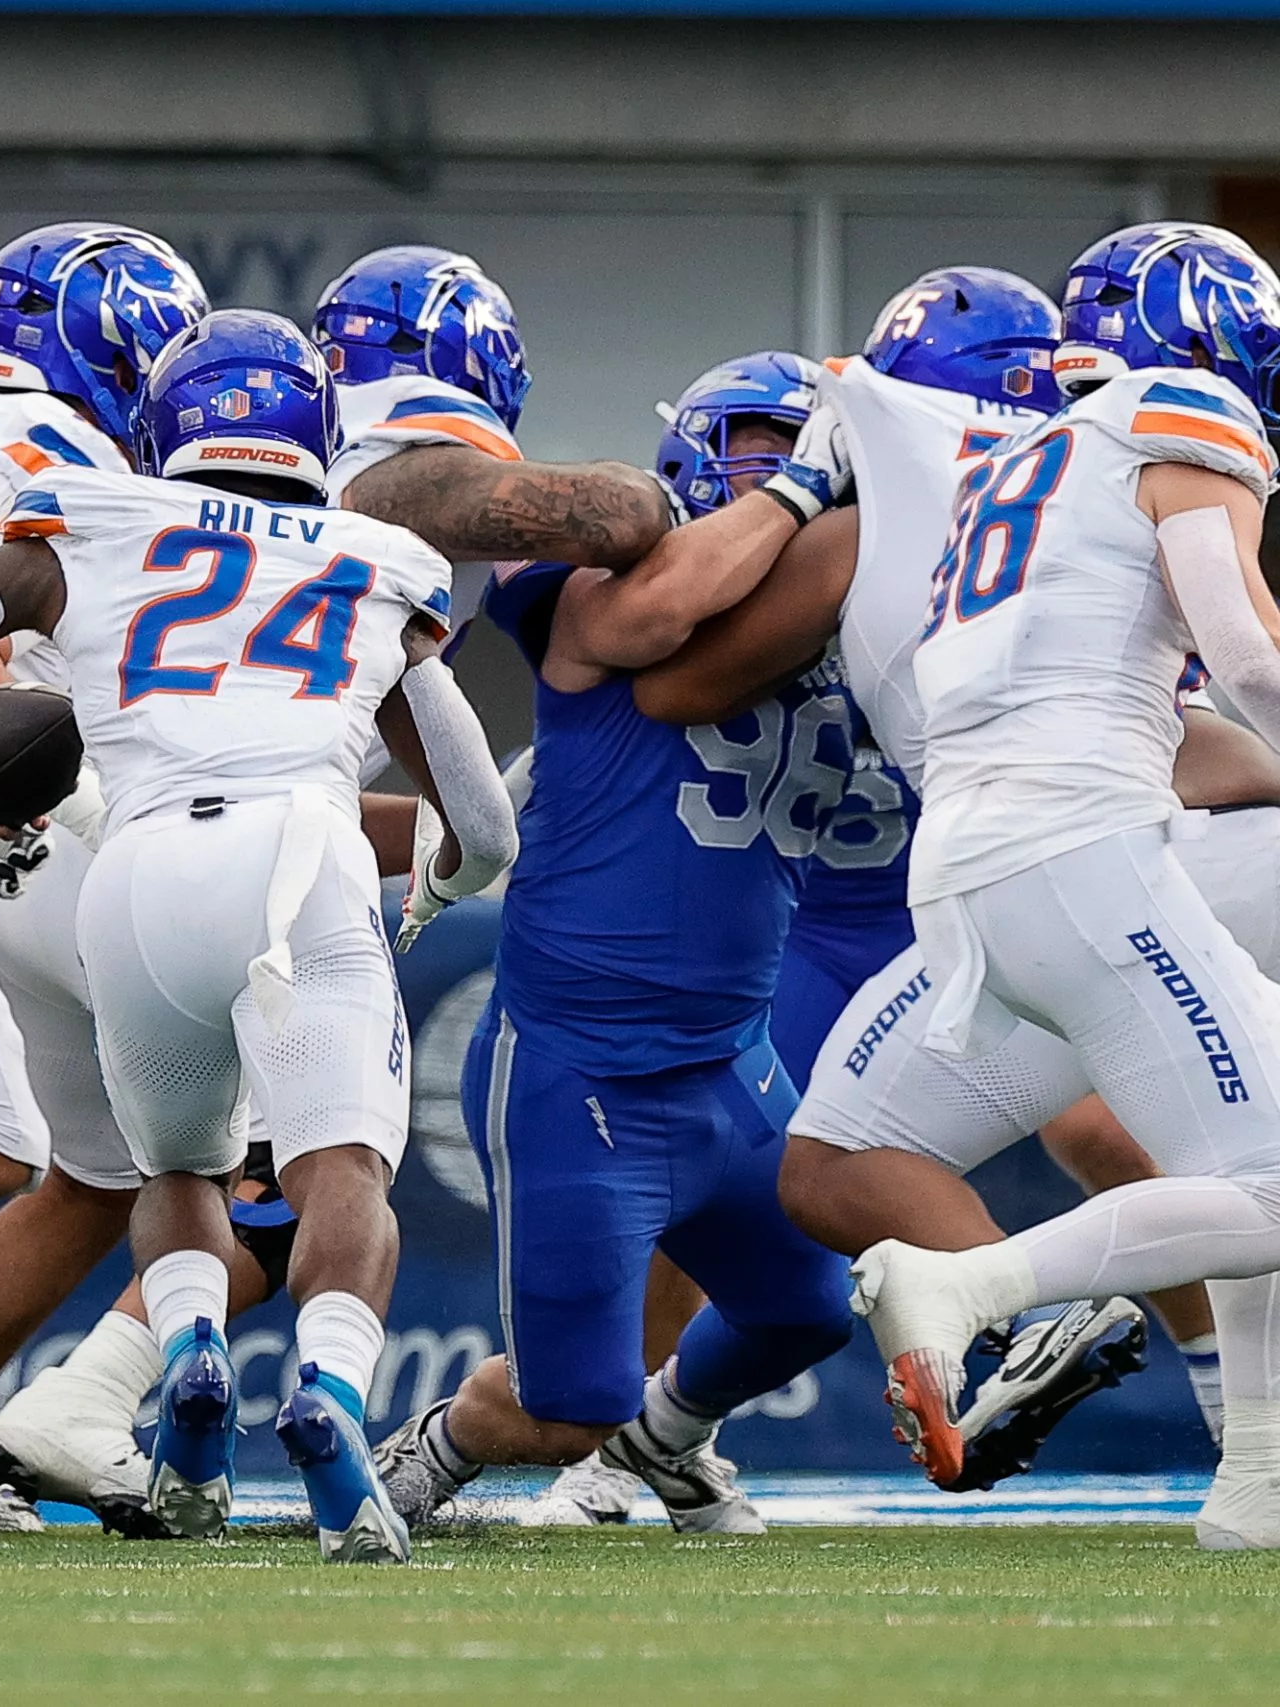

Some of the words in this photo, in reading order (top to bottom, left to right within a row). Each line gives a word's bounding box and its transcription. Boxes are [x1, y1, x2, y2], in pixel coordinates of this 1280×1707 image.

[199, 446, 301, 468] BRONCOS
[118, 525, 376, 710] 24
[1126, 924, 1250, 1104] BRONCOS
